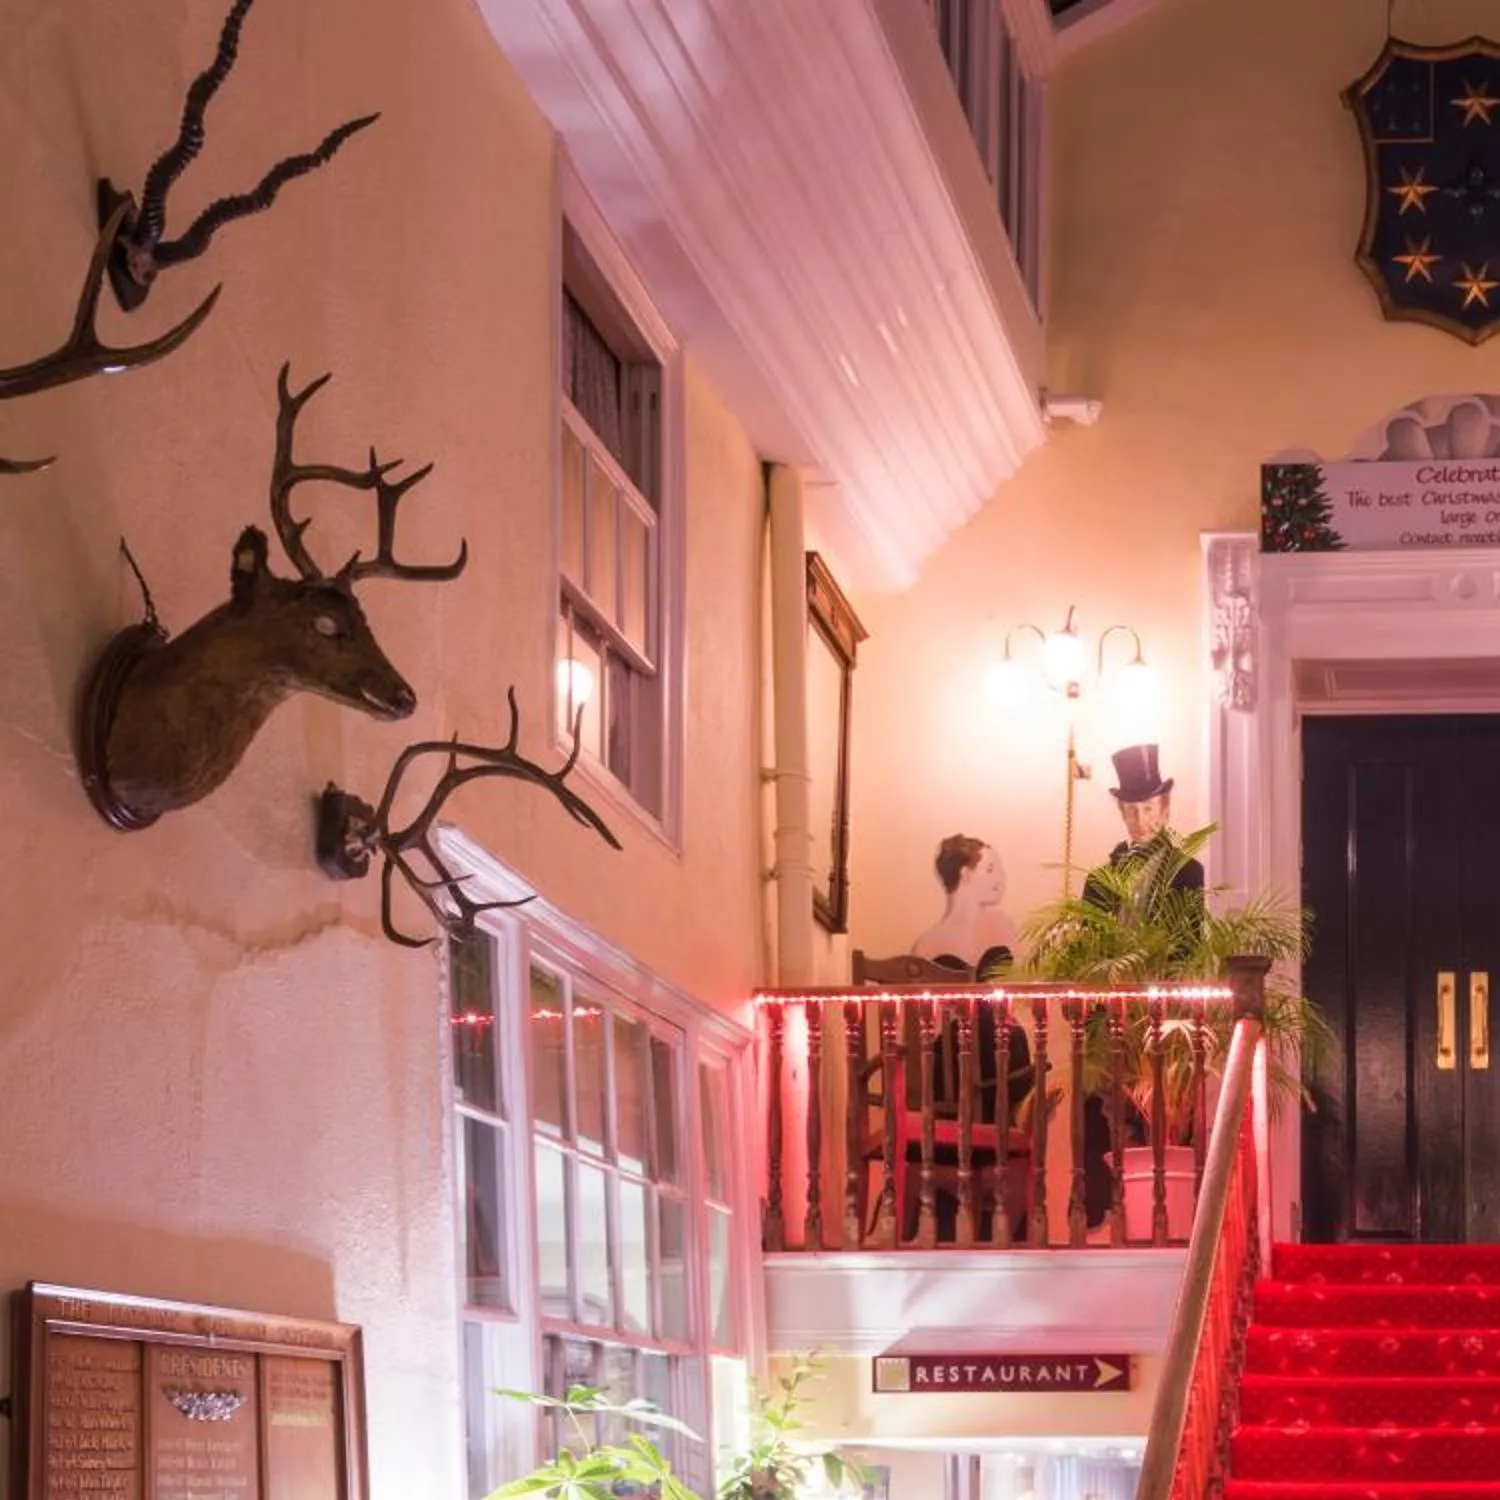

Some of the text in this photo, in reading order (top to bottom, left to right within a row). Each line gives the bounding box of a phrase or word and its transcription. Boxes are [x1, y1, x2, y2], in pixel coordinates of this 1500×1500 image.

[1345, 490, 1372, 508] The
[1378, 491, 1411, 507] best
[1440, 510, 1477, 528] large
[1399, 531, 1452, 545] Contact
[915, 1365, 1089, 1383] RESTAURANT
